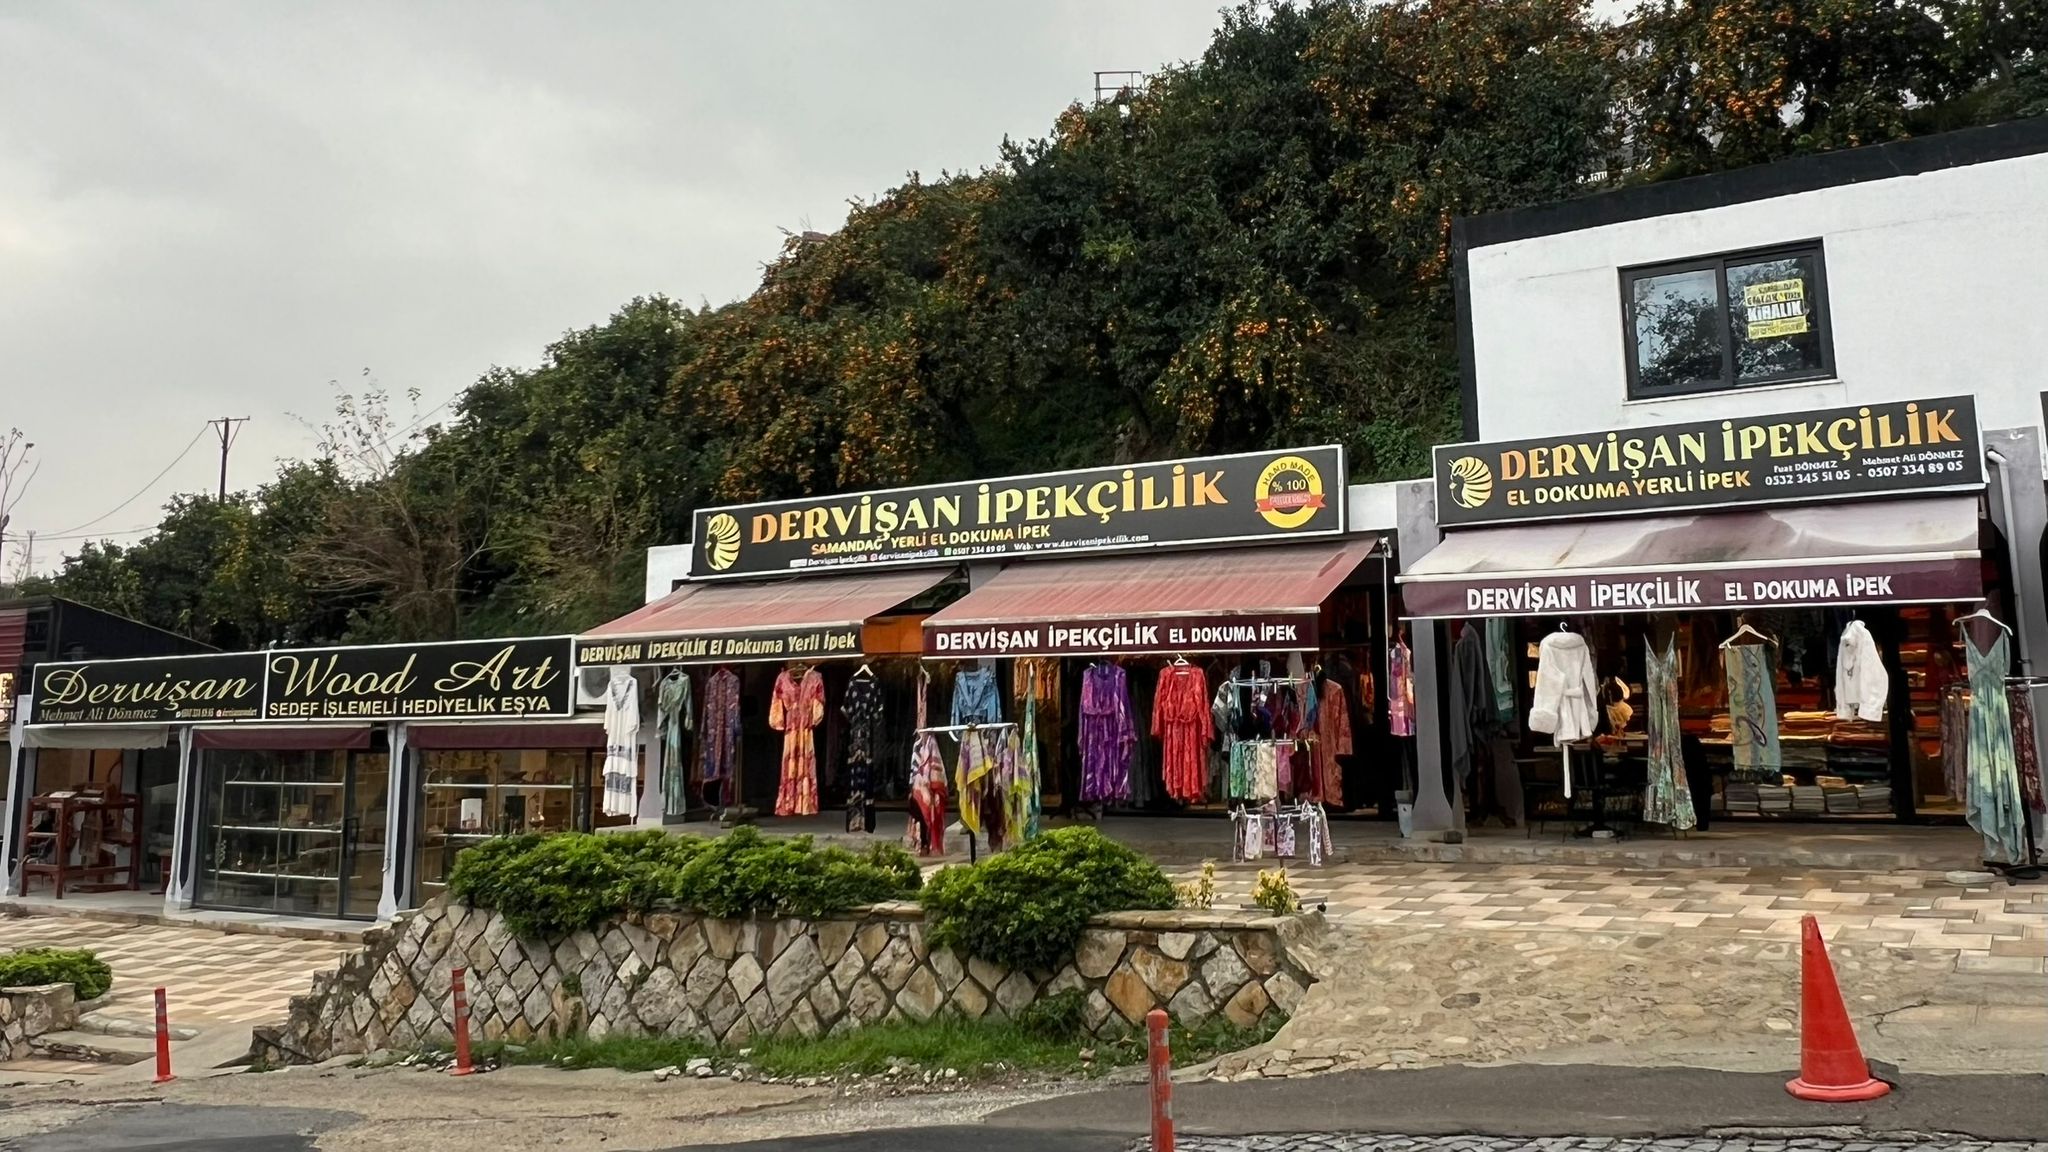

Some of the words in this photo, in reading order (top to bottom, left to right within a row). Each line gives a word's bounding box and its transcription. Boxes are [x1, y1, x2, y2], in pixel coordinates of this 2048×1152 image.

[1500, 431, 1706, 481] DERVİŞAN
[1721, 402, 1962, 461] İPEKÇİLİK
[1902, 453, 1916, 463] Ali
[1918, 450, 1964, 462] DÖNMEZ
[1263, 462, 1287, 486] HAND
[1290, 461, 1315, 482] MADE
[1765, 475, 1793, 486] 0532
[1797, 473, 1818, 484] 345
[1822, 471, 1833, 482] 51
[1836, 469, 1850, 480] 05
[1867, 467, 1897, 478] 0507
[1902, 464, 1924, 476] 334
[1928, 462, 1944, 473] 89
[1947, 460, 1963, 472] 05
[1794, 460, 1838, 471] DÖNMEZ
[1286, 479, 1306, 491] 100
[1507, 489, 1530, 506] EL
[1535, 481, 1630, 504] DOKUMA
[1633, 470, 1693, 496] YERLİ
[1700, 469, 1751, 491] İPEK
[751, 494, 960, 544] DERVİŞAN
[978, 464, 1228, 524] İPEKÇİLİK
[811, 535, 883, 555] SAMANDAĞ
[891, 532, 926, 549] YERLİ
[930, 533, 946, 546] EL
[949, 527, 1014, 544] DOKUMA
[1018, 523, 1051, 539] İPEK
[1467, 582, 1576, 613] DERVİŞAN
[1590, 576, 1700, 609] İPEKÇİLİK
[1725, 582, 1747, 602] EL
[1754, 578, 1840, 600] DOKUMA
[1847, 573, 1893, 597] İPEK
[580, 643, 641, 664] DERVİŞAN
[648, 637, 707, 660] İPEKÇİLİK
[709, 639, 723, 655] El
[726, 637, 783, 655] Dokuma
[788, 633, 820, 652] Yerli
[823, 630, 855, 651] İpek
[936, 627, 1039, 652] DERVİŞAN
[1049, 622, 1159, 650] İPEKÇİLİK
[1169, 628, 1187, 643] EL
[1191, 625, 1257, 643] DOKUMA
[1260, 622, 1297, 641] İPEK
[271, 653, 418, 697] Wood
[434, 645, 560, 691] Art
[40, 665, 257, 711] Dervişan
[38, 707, 83, 721] Mehmet
[87, 706, 103, 720] Ali
[106, 705, 159, 720] Dönmez
[269, 701, 319, 716] SEDEF
[323, 697, 397, 718] İŞLEMELİ
[402, 694, 496, 714] HEDİYELİK
[501, 695, 551, 715] EŞYA
